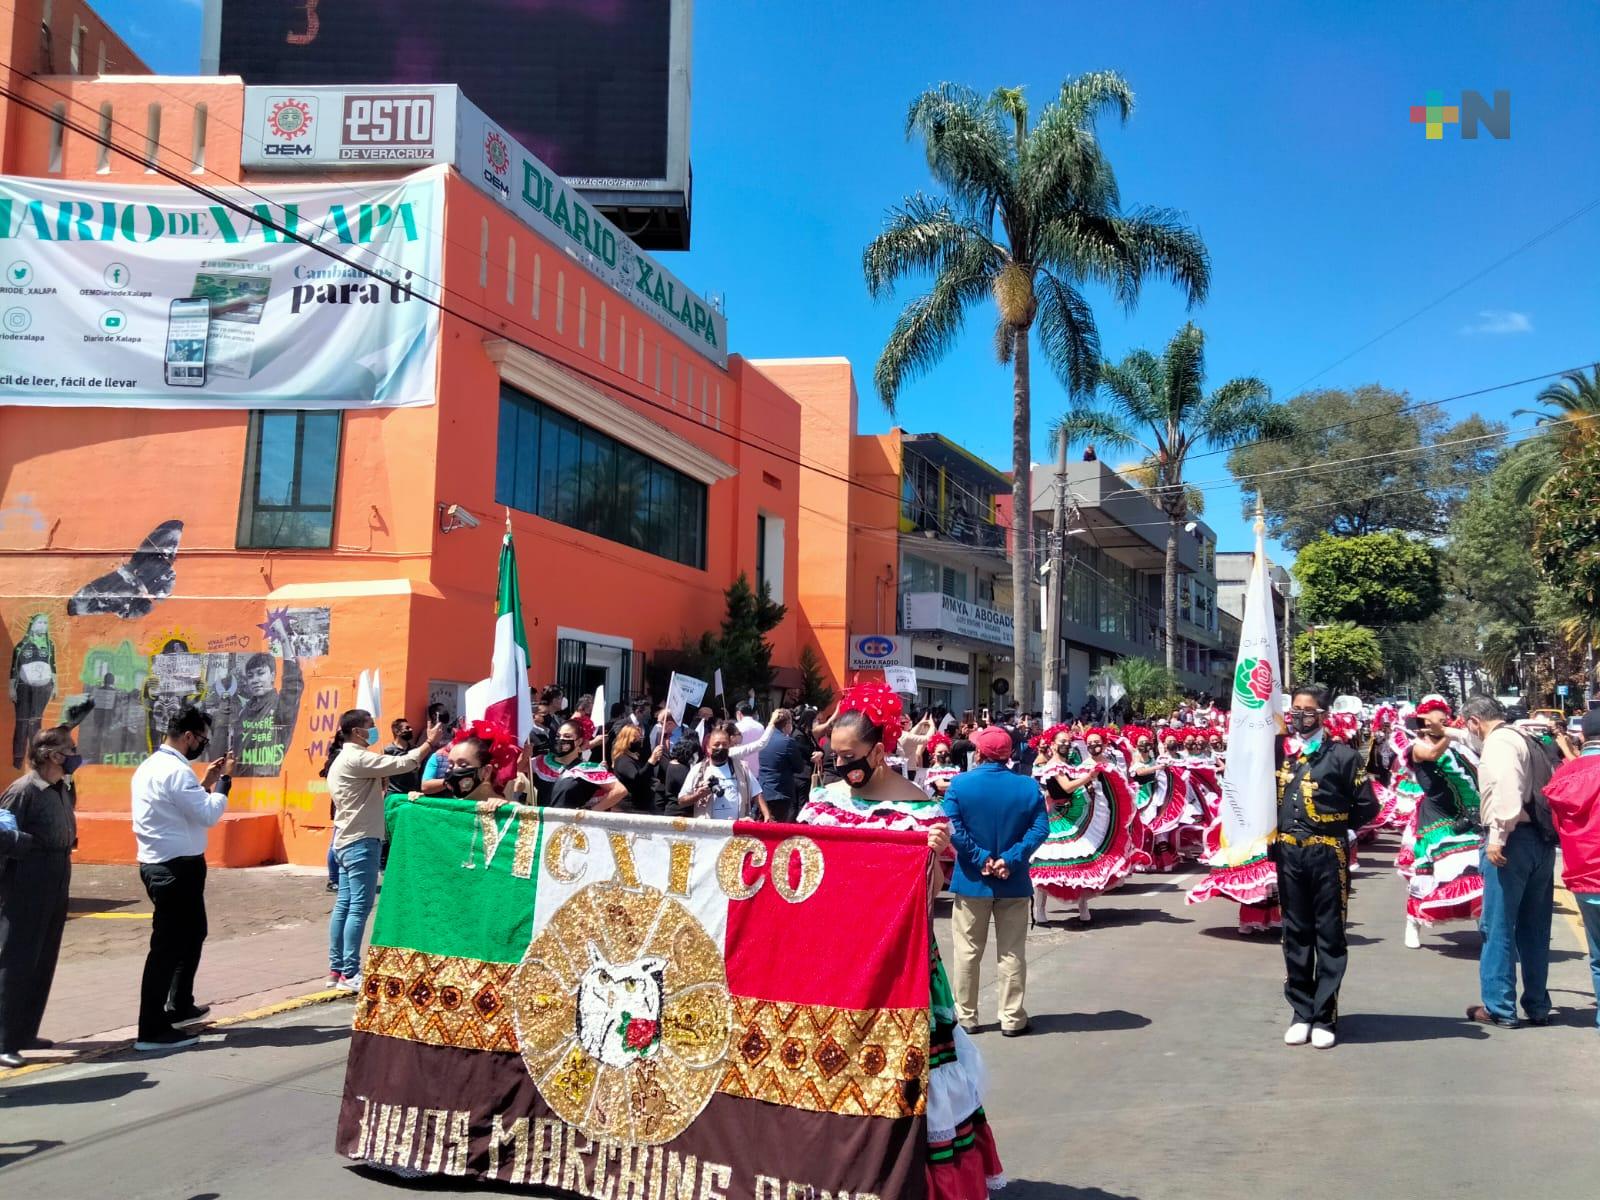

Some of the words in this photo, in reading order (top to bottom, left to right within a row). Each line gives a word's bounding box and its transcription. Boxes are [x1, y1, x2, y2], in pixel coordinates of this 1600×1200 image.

[264, 144, 313, 155] OEM
[342, 149, 359, 159] DE
[366, 149, 433, 159] VERACRUZ
[483, 169, 510, 196] OEM
[168, 212, 209, 236] DE
[208, 202, 418, 244] XALAPA
[522, 158, 617, 271] DIARIO
[635, 254, 719, 350] XALAPA
[291, 283, 380, 314] para
[389, 270, 413, 304] ti
[15, 376, 30, 385] de
[32, 376, 58, 387] leer,
[61, 376, 86, 387] fácil
[88, 377, 102, 387] de
[104, 377, 138, 388] llevar
[975, 608, 1014, 629] ABOGADO
[316, 689, 338, 709] NI
[242, 732, 249, 742] Y
